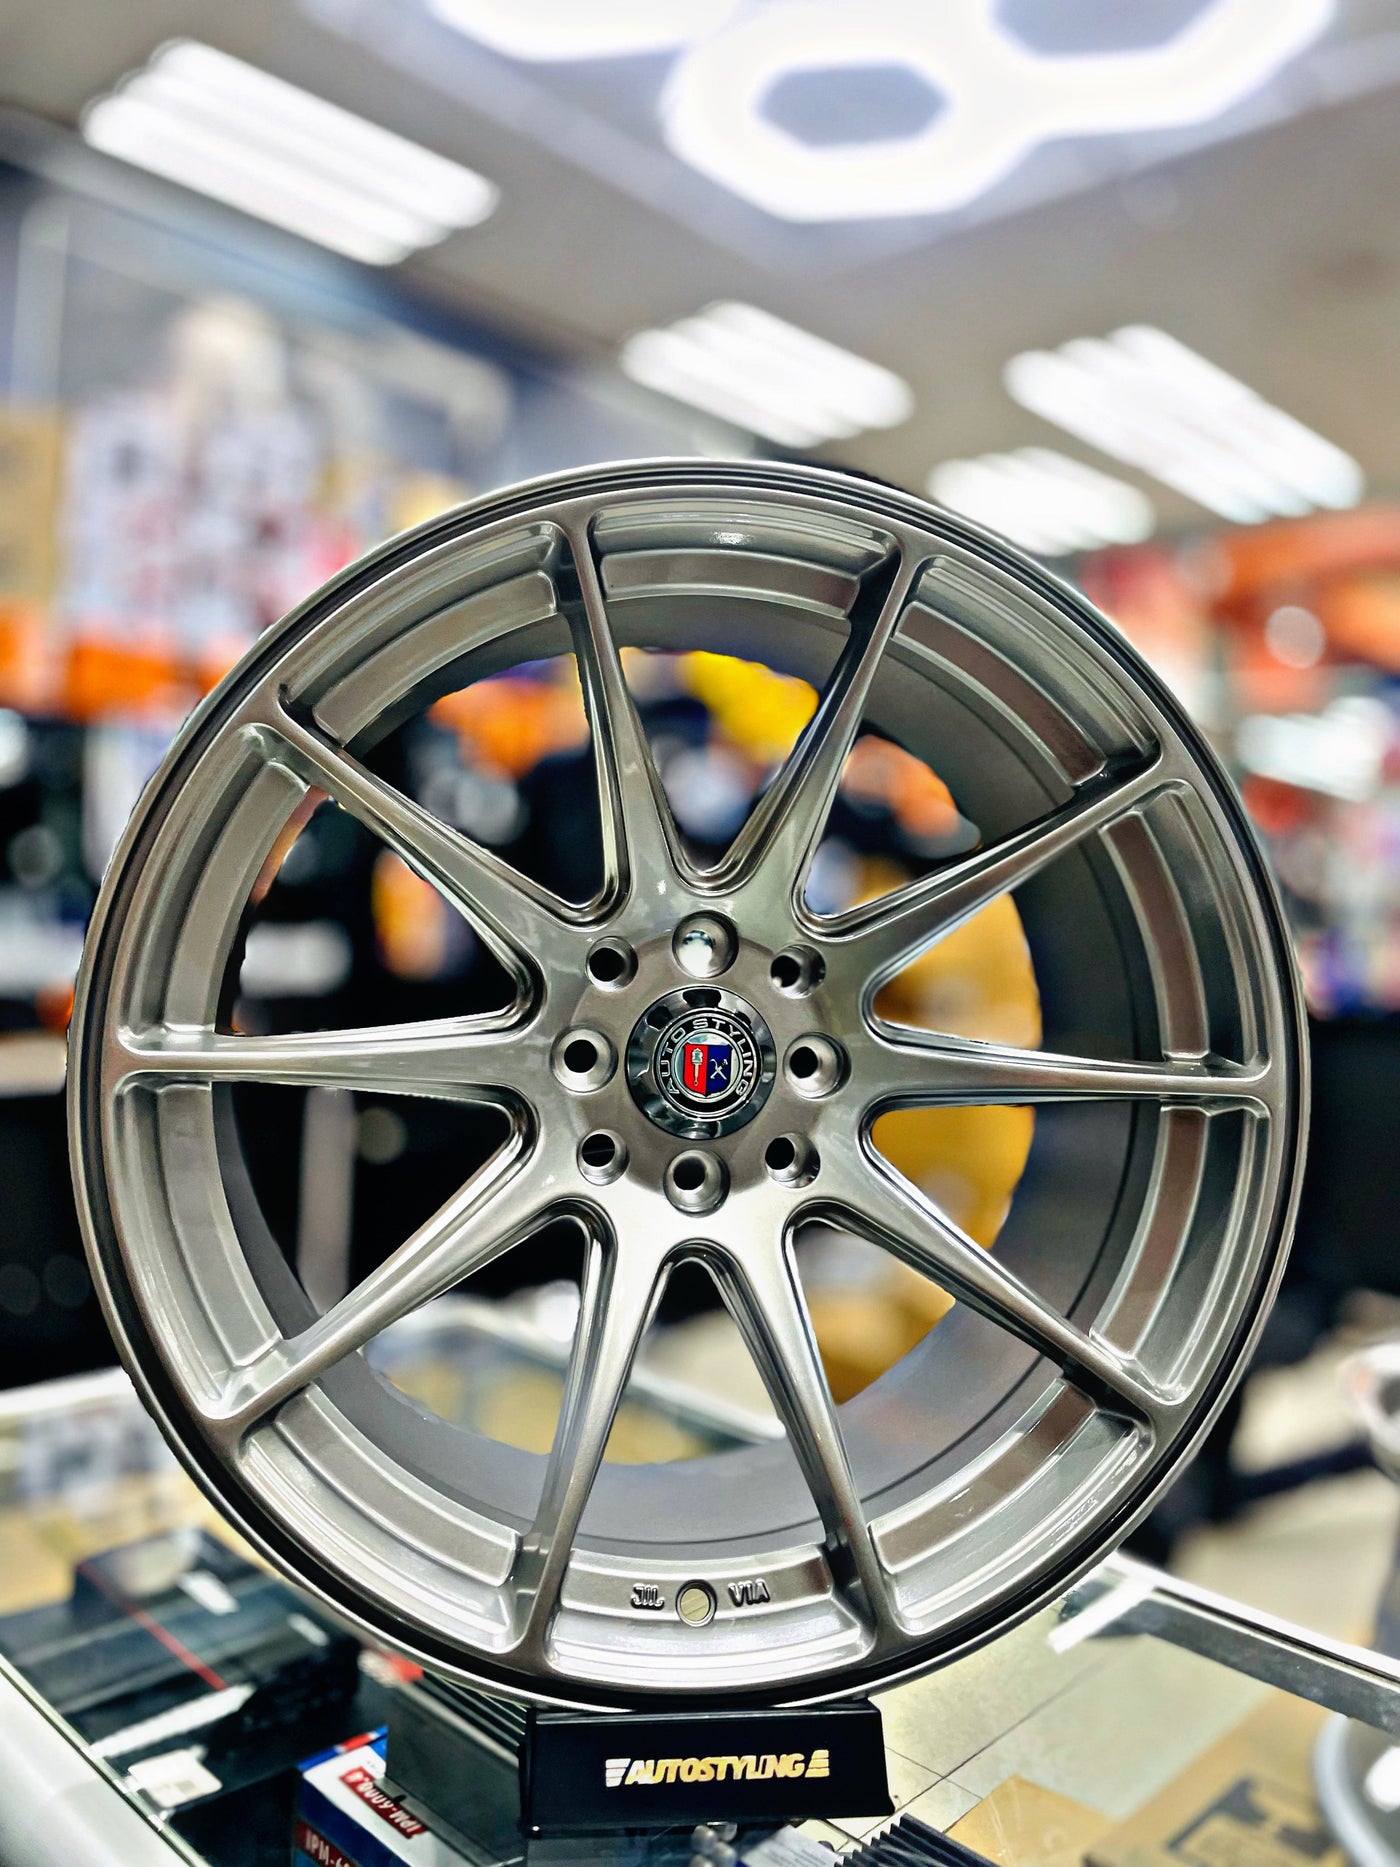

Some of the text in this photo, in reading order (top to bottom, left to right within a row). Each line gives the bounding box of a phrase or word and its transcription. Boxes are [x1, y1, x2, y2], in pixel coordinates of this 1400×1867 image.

[660, 1018, 753, 1096] AUTO STYLING
[727, 1577, 771, 1607] VIA
[625, 1752, 806, 1786] AUTOSTYLING
